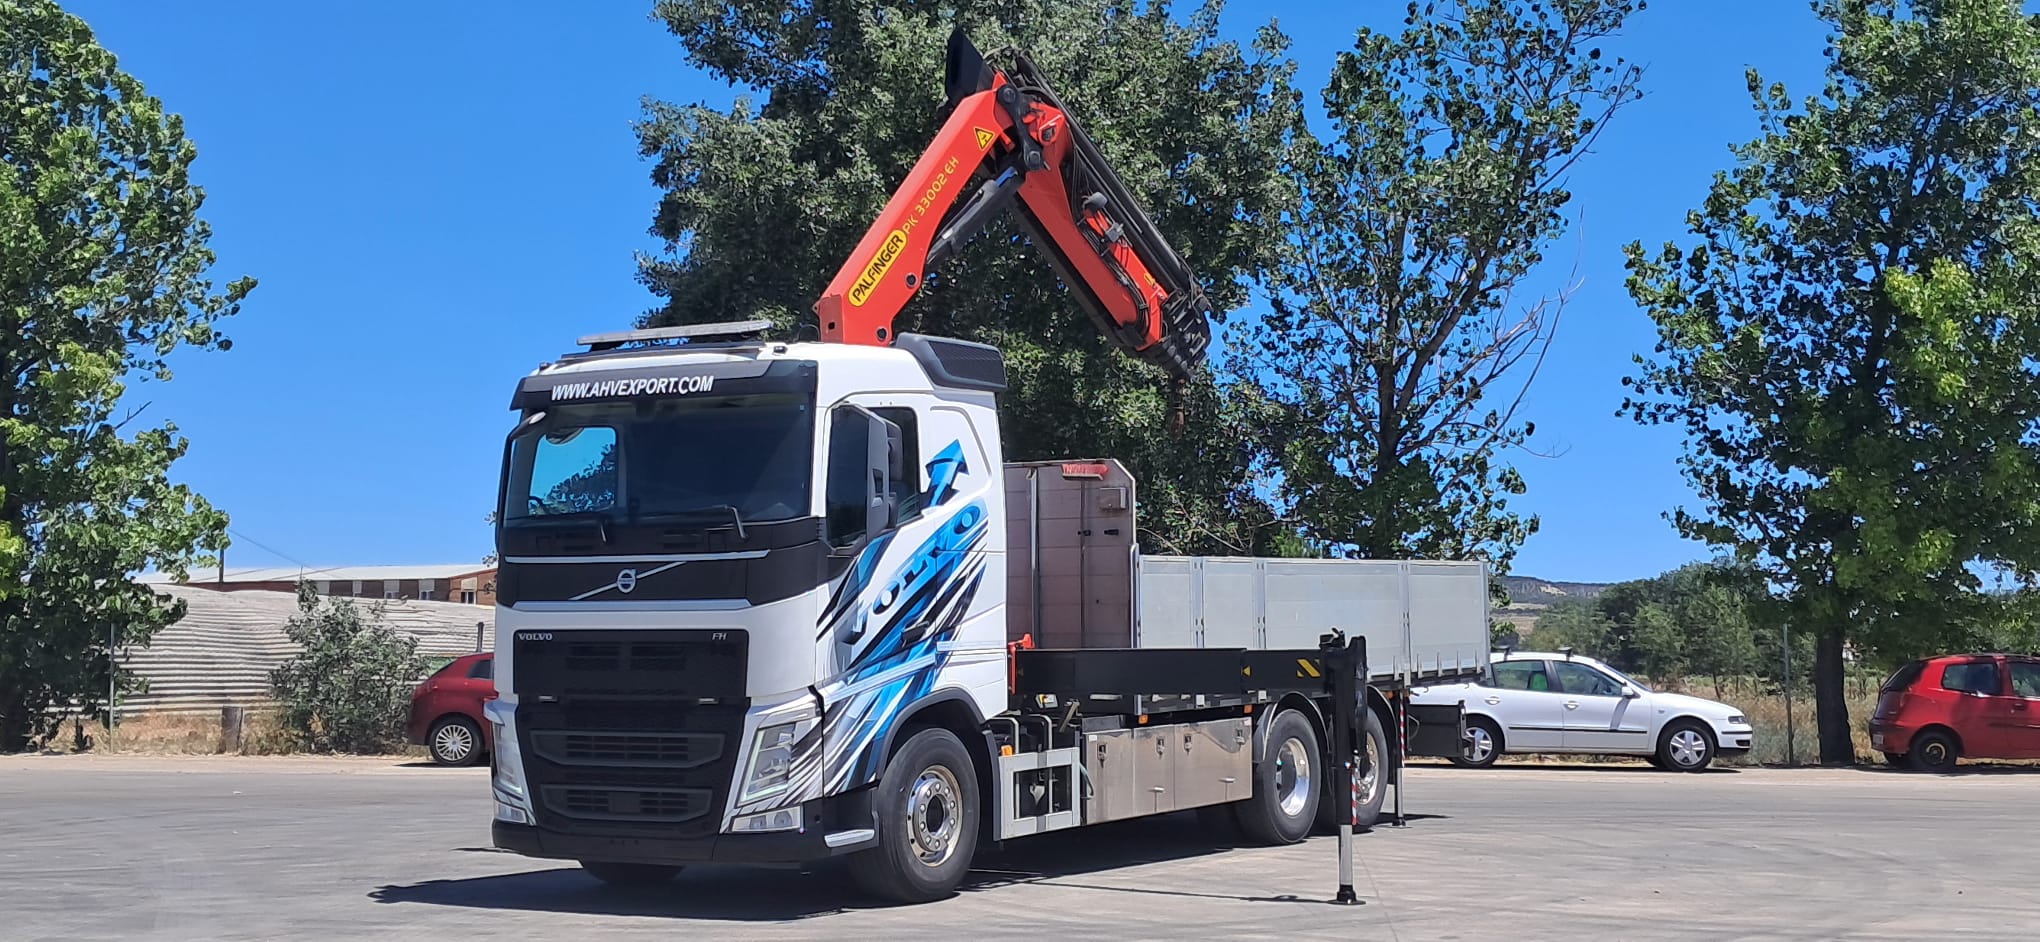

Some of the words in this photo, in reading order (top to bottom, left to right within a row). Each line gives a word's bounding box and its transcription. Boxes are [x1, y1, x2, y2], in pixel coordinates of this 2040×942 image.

[852, 234, 904, 302] PALFINGER
[902, 214, 919, 235] PK
[915, 172, 948, 216] 33002
[944, 156, 960, 175] EH
[551, 375, 714, 401] WWW.AHVEXPORT.COM
[518, 632, 553, 641] VOLVO
[711, 632, 727, 641] FH
